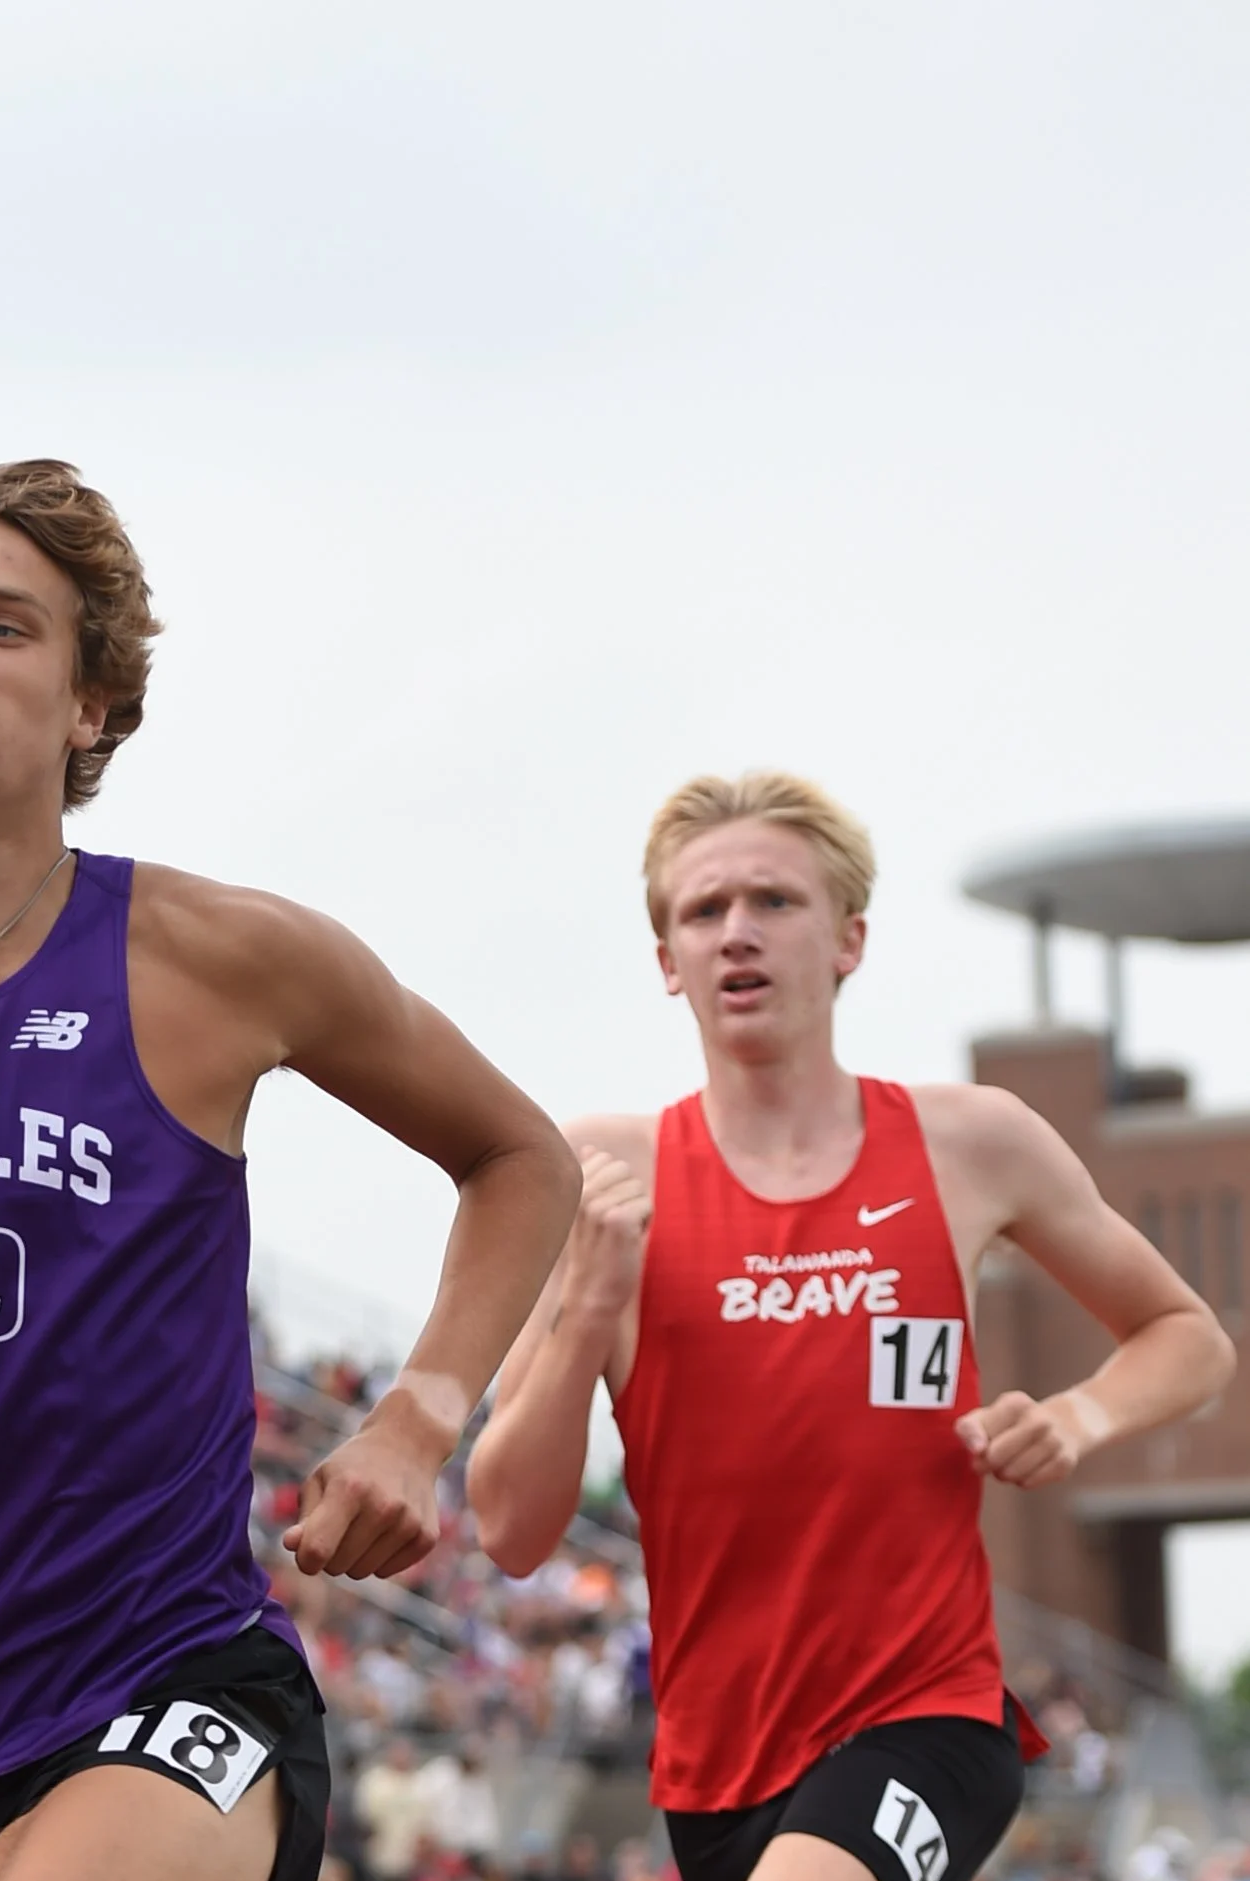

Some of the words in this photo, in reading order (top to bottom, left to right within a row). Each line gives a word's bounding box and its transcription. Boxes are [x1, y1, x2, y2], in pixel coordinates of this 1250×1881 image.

[10, 1009, 89, 1051] NB
[717, 1269, 901, 1323] BRAVE
[881, 1323, 950, 1403] 14
